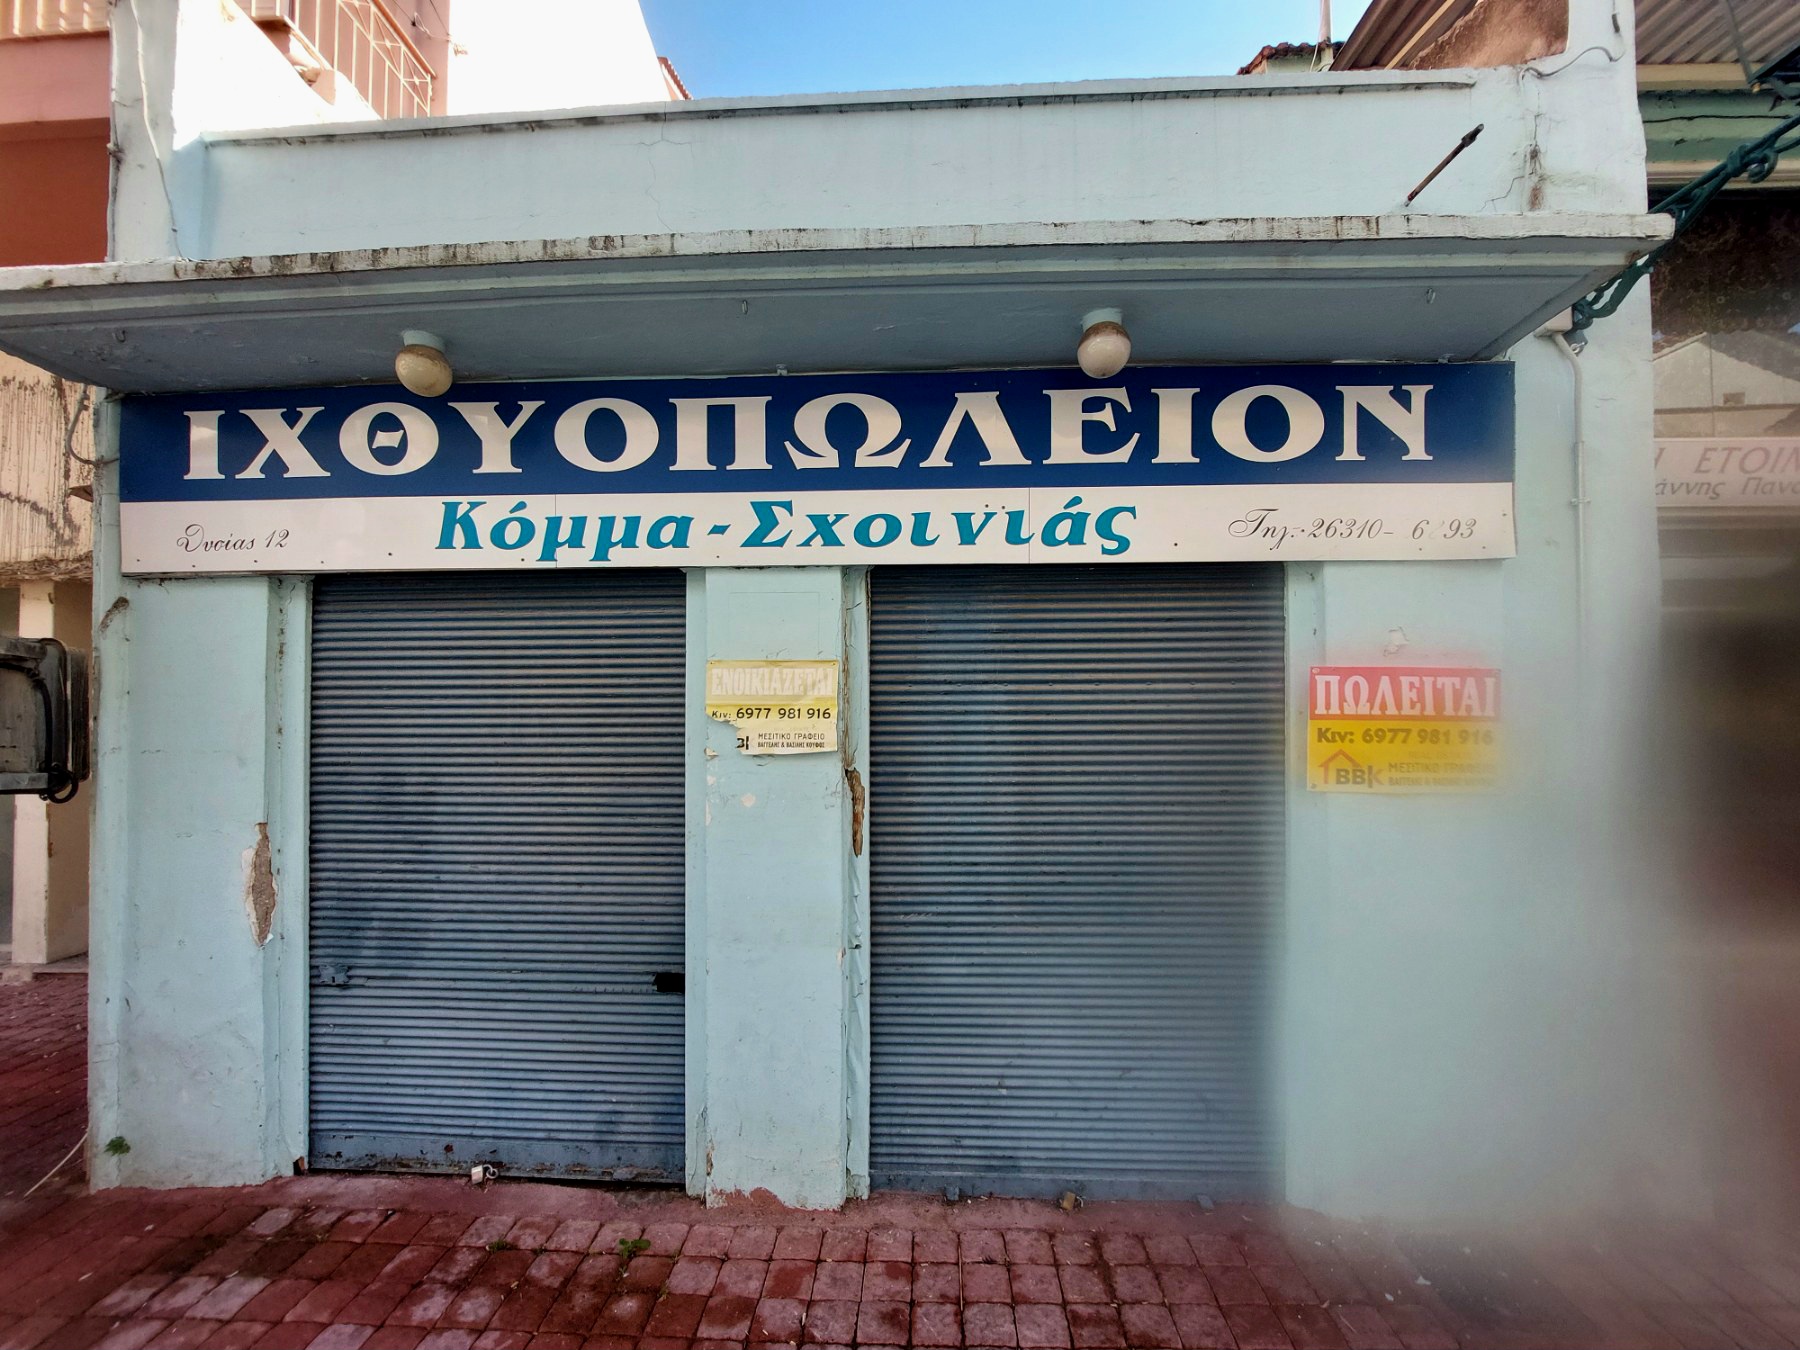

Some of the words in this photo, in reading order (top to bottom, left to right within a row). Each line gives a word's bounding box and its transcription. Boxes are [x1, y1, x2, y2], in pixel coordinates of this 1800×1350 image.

[183, 384, 1434, 480] ΙΧΘΥΟΠΩΛΕΙΟΝ
[265, 528, 290, 549] 12
[711, 667, 833, 696] ΕΝΟΙΚΙΑΖΕΤΑΙ
[1315, 675, 1497, 717] ΠΩΛΕΙΤΑΙ
[736, 707, 771, 719] 6977
[778, 707, 801, 719] 981
[806, 707, 831, 719] 916
[1317, 727, 1355, 744] Κιν:
[1362, 727, 1411, 744] 6977
[1418, 728, 1451, 744] 981
[1458, 729, 1494, 745] 916
